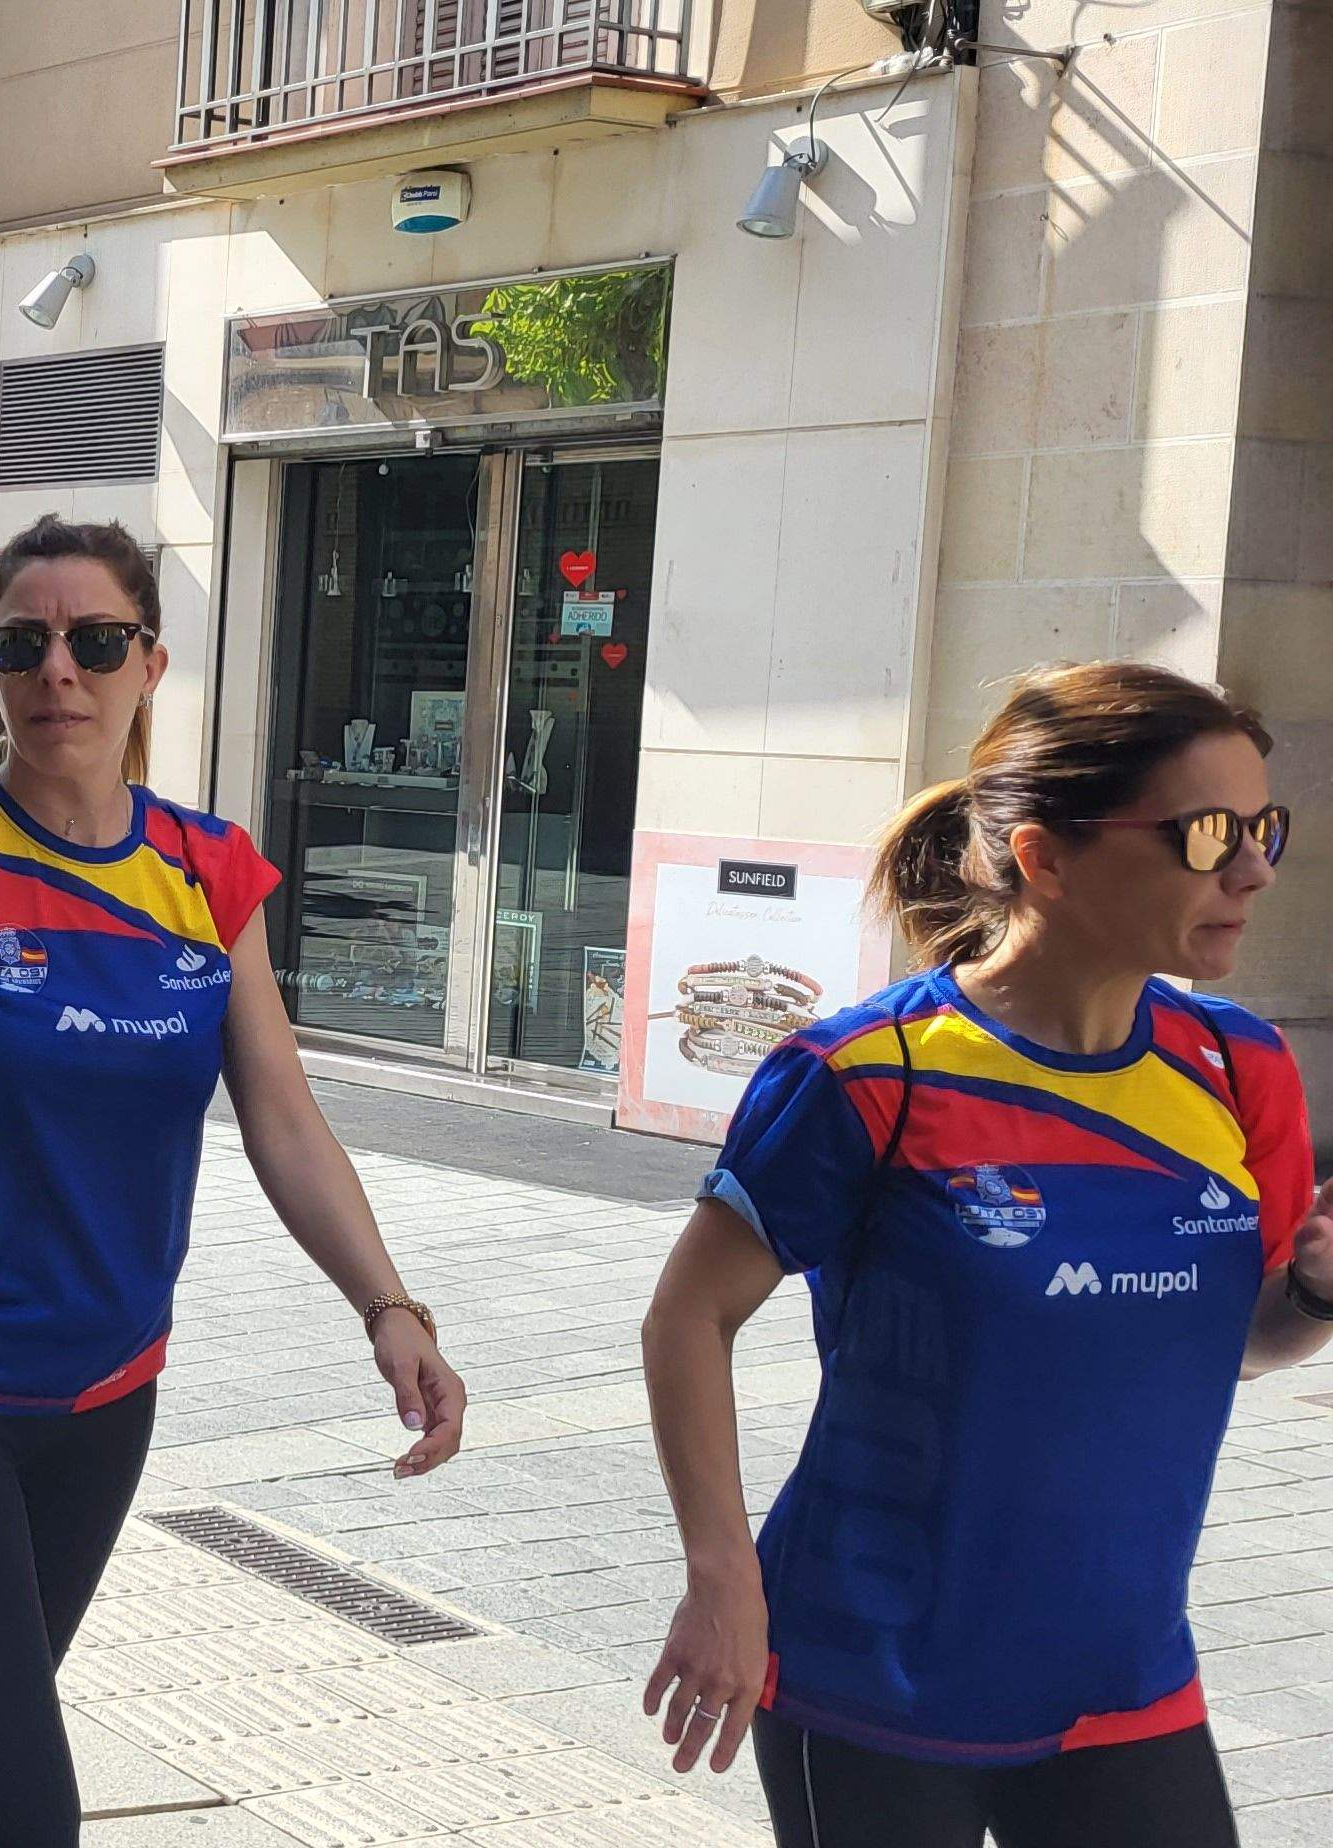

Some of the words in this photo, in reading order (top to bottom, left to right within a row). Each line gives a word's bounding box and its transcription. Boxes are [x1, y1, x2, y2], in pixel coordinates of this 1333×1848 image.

[351, 312, 505, 399] TAS
[728, 870, 786, 888] SUNFIELD
[19, 967, 46, 978] 091
[158, 969, 231, 991] Santande
[111, 1010, 189, 1040] mupol
[1172, 1214, 1260, 1236] Santander
[1111, 1263, 1198, 1300] mupol
